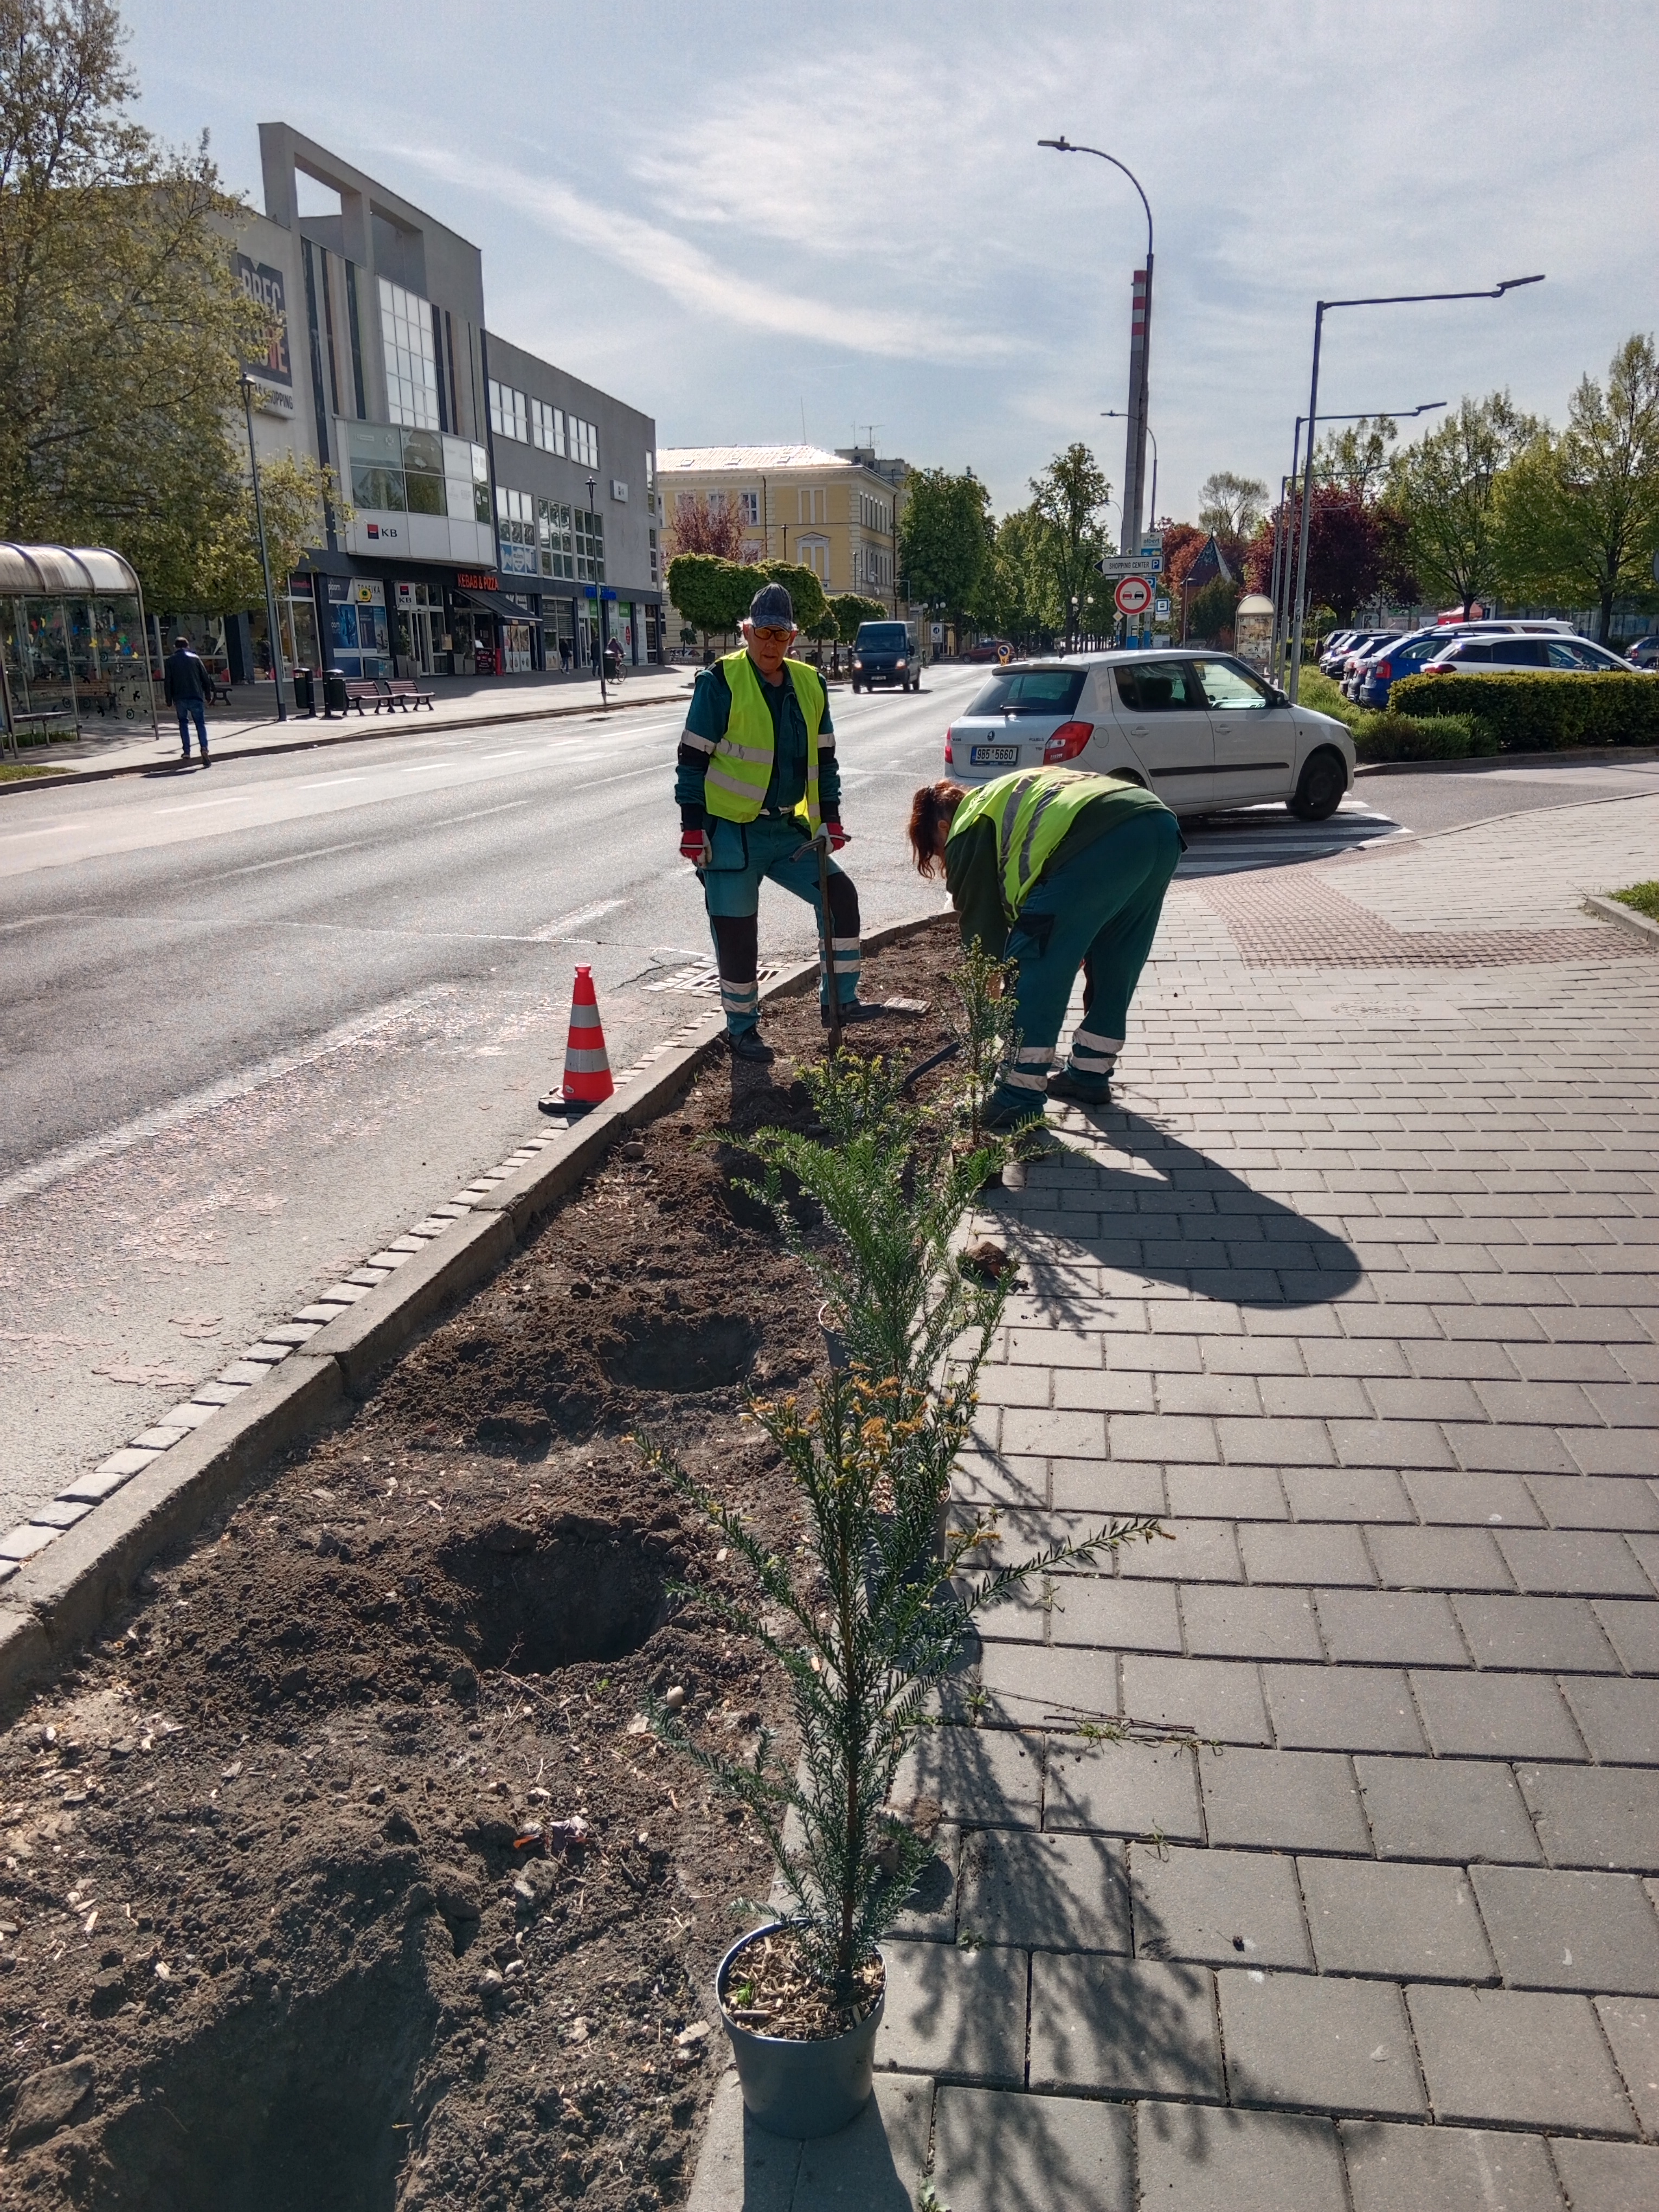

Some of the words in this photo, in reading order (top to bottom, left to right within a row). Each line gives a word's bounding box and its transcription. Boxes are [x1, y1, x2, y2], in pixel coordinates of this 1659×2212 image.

[382, 529, 397, 537] KB
[458, 573, 478, 589] KEBAB
[478, 577, 484, 589] &
[483, 576, 499, 590] PIZZA
[977, 749, 990, 760] 9B5
[995, 749, 1013, 760] 5660
